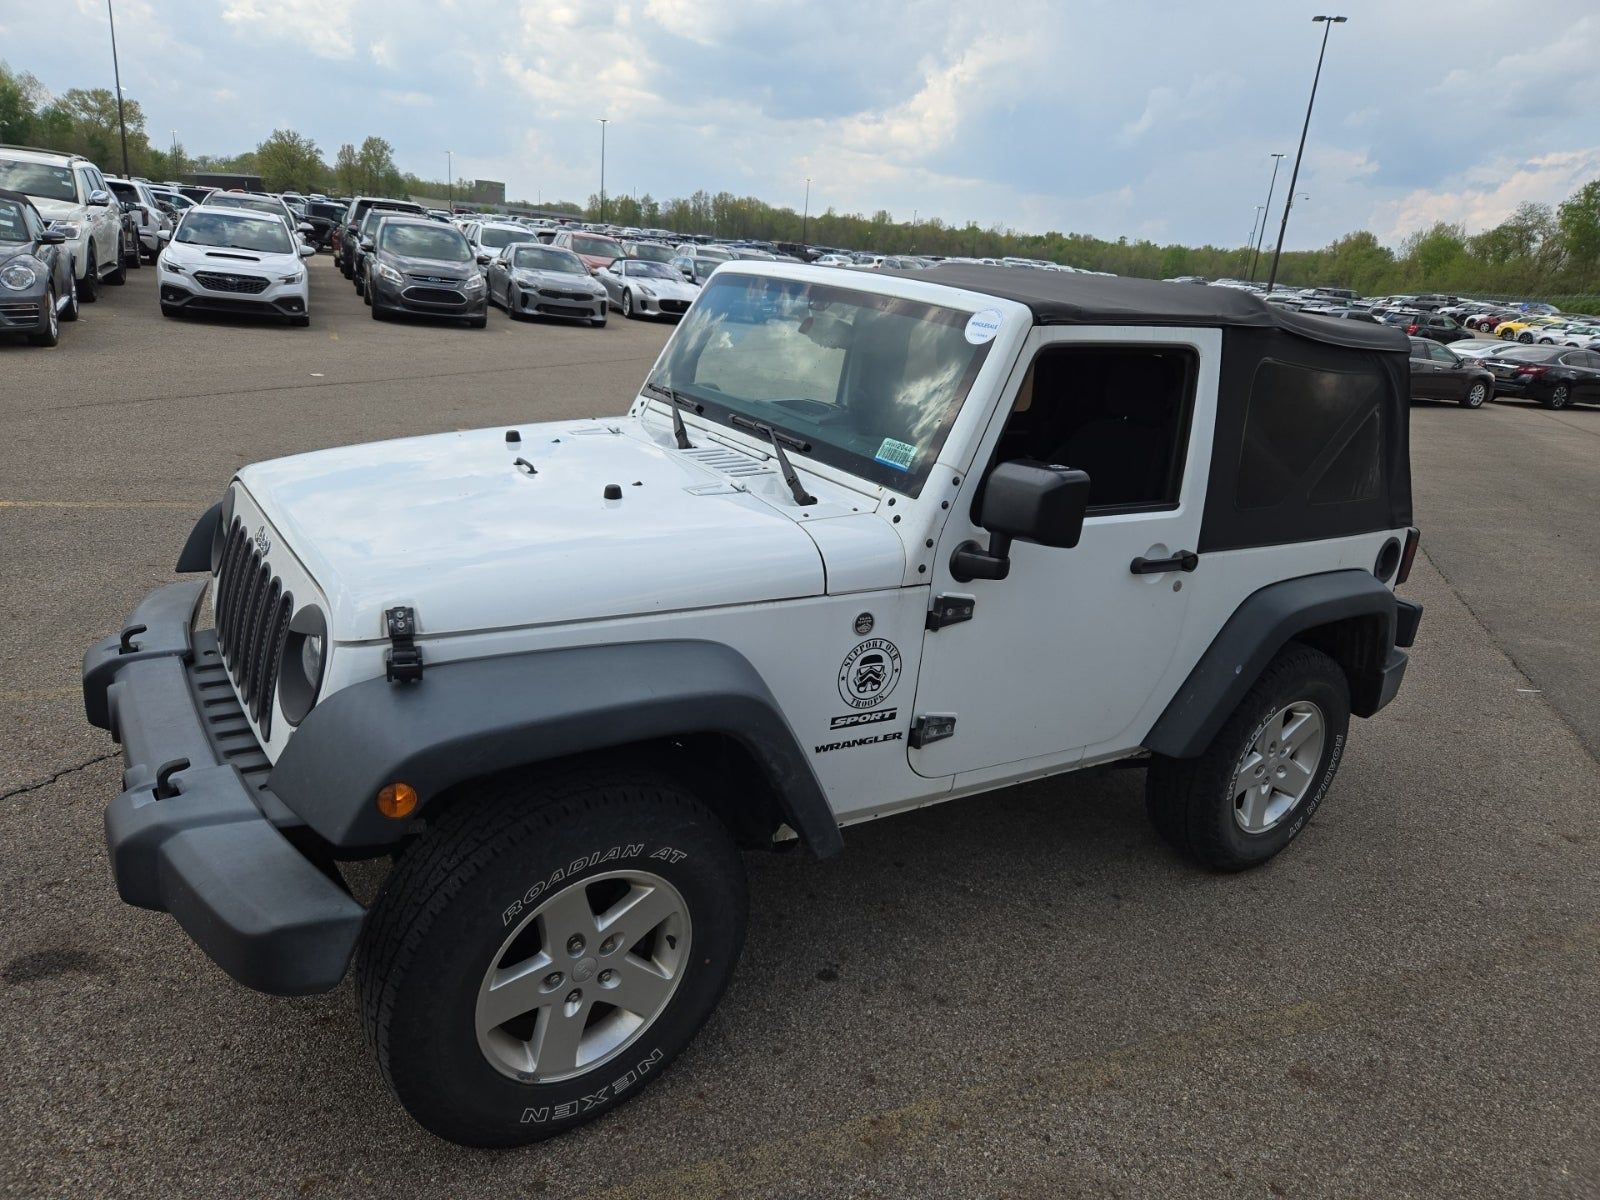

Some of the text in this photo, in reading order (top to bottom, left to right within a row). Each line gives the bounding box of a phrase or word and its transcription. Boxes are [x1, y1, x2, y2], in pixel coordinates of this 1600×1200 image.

[844, 640, 899, 668] SUPPORT OUR
[850, 693, 885, 708] TROOPS
[833, 710, 894, 725] SPORT
[815, 732, 903, 753] WRANGLER
[502, 844, 688, 926] ROADIAN AT
[520, 1048, 664, 1123] NEXEN
